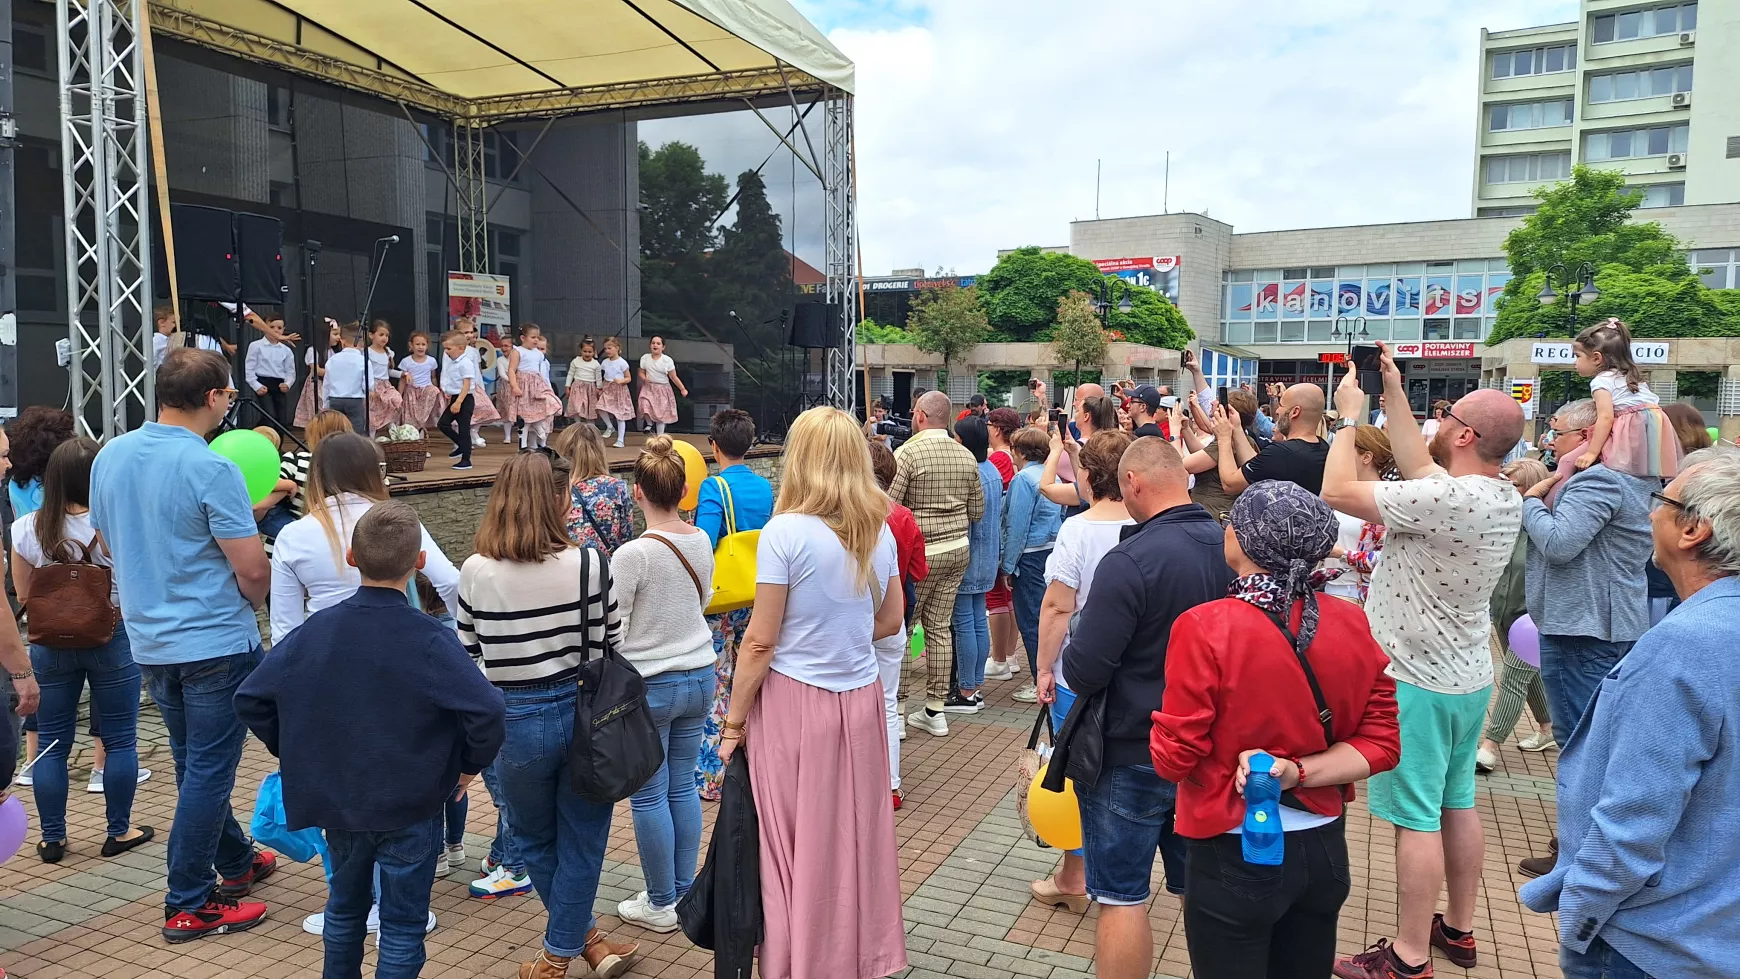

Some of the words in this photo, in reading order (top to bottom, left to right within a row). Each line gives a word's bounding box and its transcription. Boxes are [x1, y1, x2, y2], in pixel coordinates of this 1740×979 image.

[873, 281, 909, 291] DROGERIE
[1259, 285, 1478, 313] kanovits
[1397, 345, 1419, 355] coop
[1424, 349, 1471, 357] ÉLELMISZER
[1535, 345, 1664, 359] REGICIÓ
[1302, 375, 1342, 383] ÉLELMIZE
